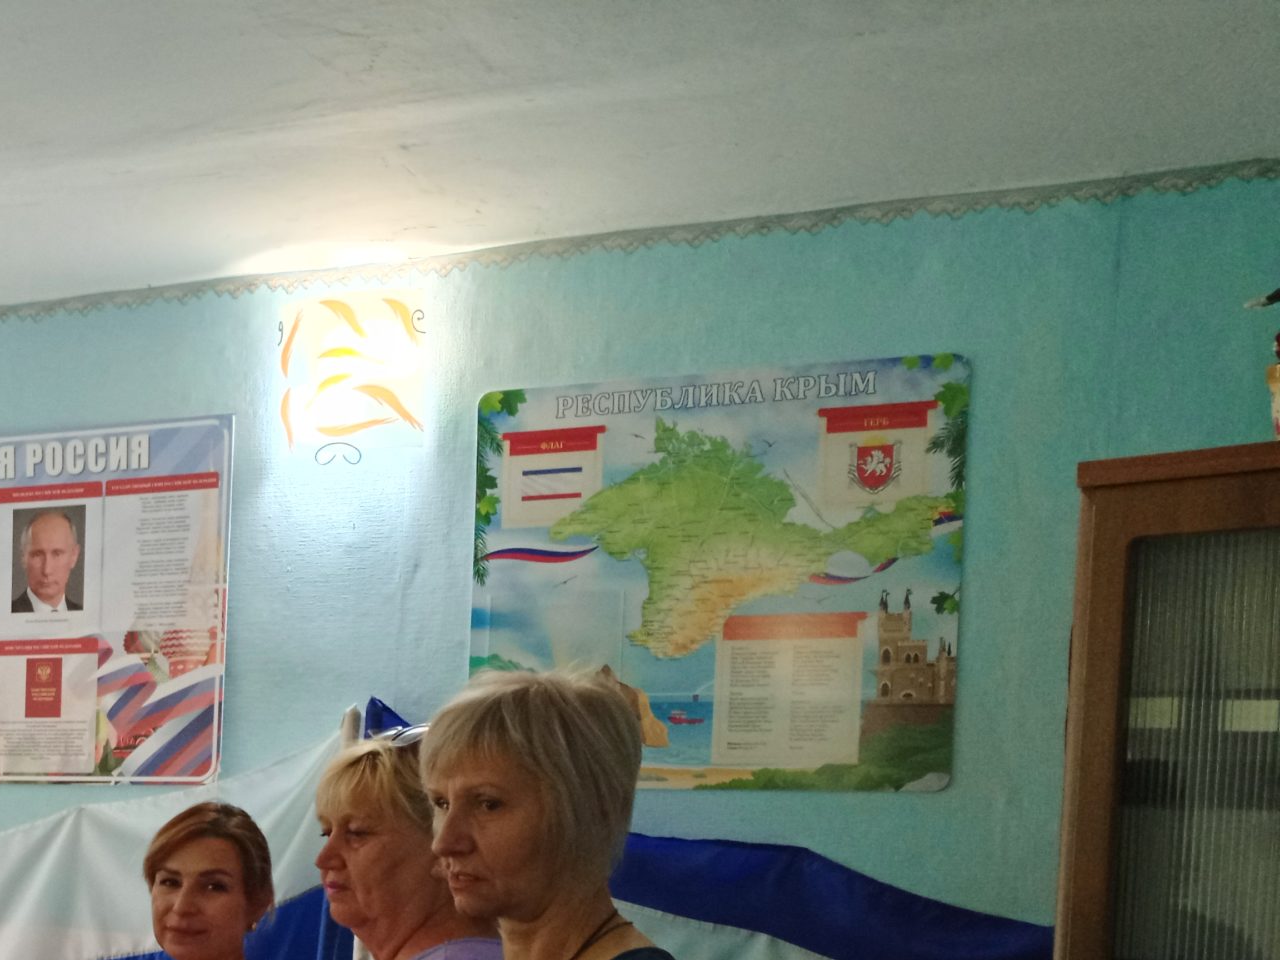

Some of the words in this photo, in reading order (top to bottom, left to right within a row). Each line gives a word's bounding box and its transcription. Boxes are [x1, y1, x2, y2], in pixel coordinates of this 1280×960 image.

[555, 379, 765, 419] РЕСПУБЛИКА
[773, 370, 877, 403] КРЫМ
[26, 434, 151, 478] РОССИЯ
[540, 440, 566, 450] ФЛАГ
